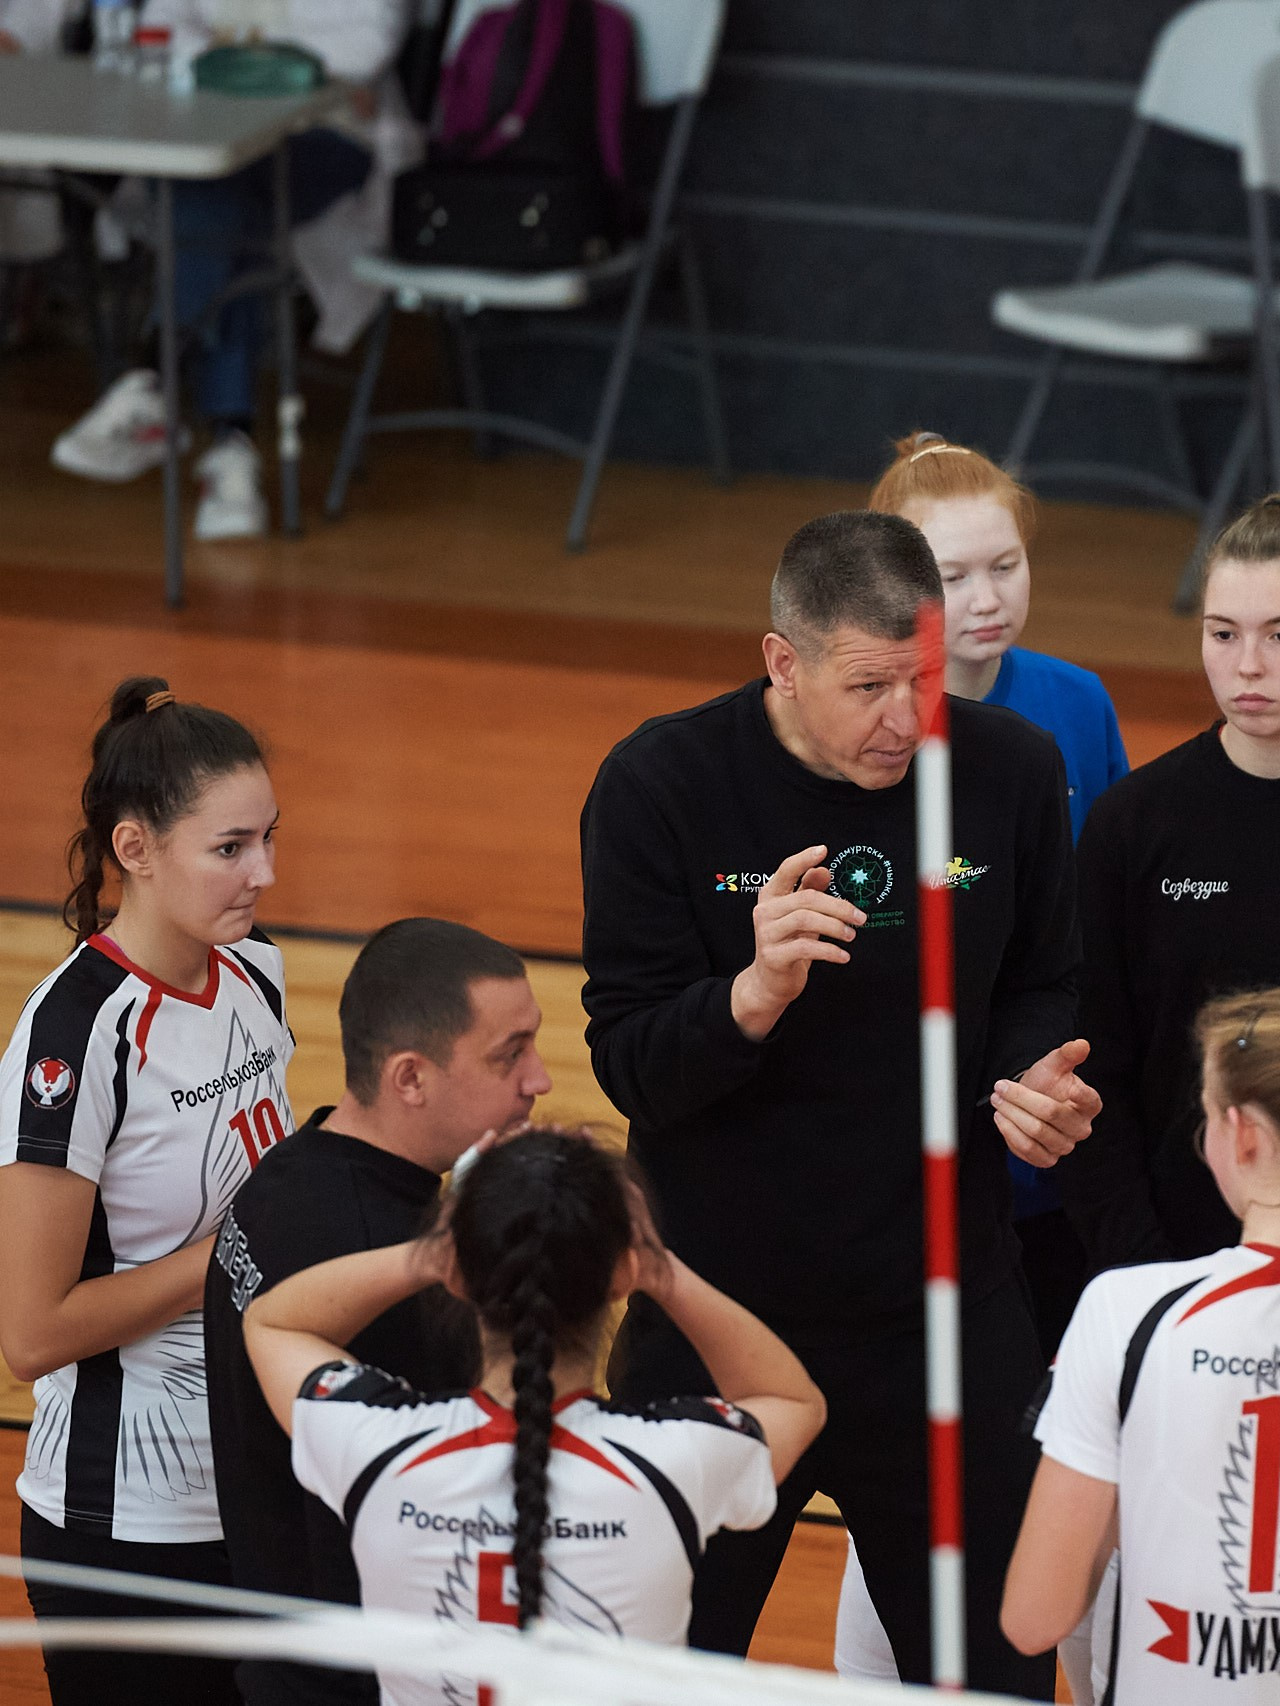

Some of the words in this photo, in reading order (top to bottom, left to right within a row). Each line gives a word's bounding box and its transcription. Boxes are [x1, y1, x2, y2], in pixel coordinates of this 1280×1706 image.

[741, 872, 775, 886] КОМ
[1161, 877, 1230, 901] Созвездие
[170, 1044, 278, 1113] РоссельхозБанк
[399, 1501, 628, 1539] РоссельБанк
